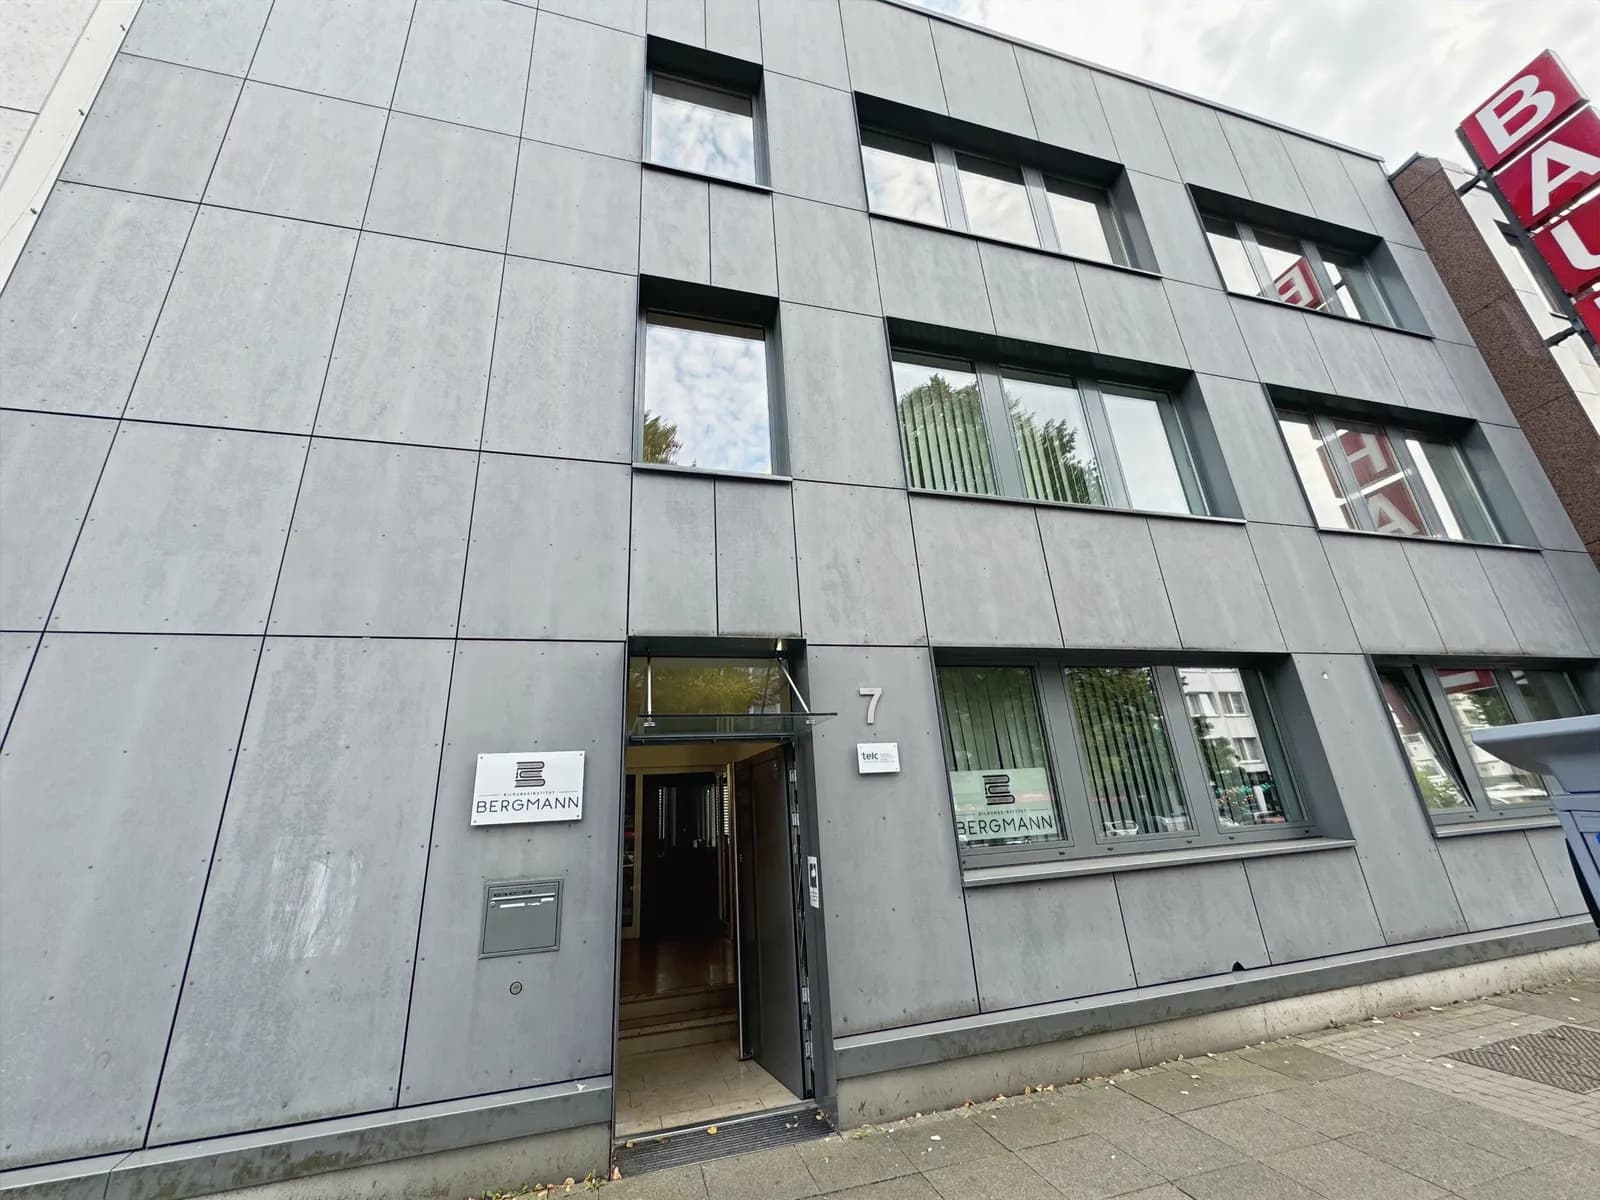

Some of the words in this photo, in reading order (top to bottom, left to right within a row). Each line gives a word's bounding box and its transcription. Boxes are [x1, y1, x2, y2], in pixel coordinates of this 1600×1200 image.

[1475, 75, 1600, 310] BAU
[859, 687, 882, 724] 7
[861, 752, 879, 761] telc
[476, 796, 579, 814] BERGMANN
[956, 814, 1053, 835] BERGMANN
